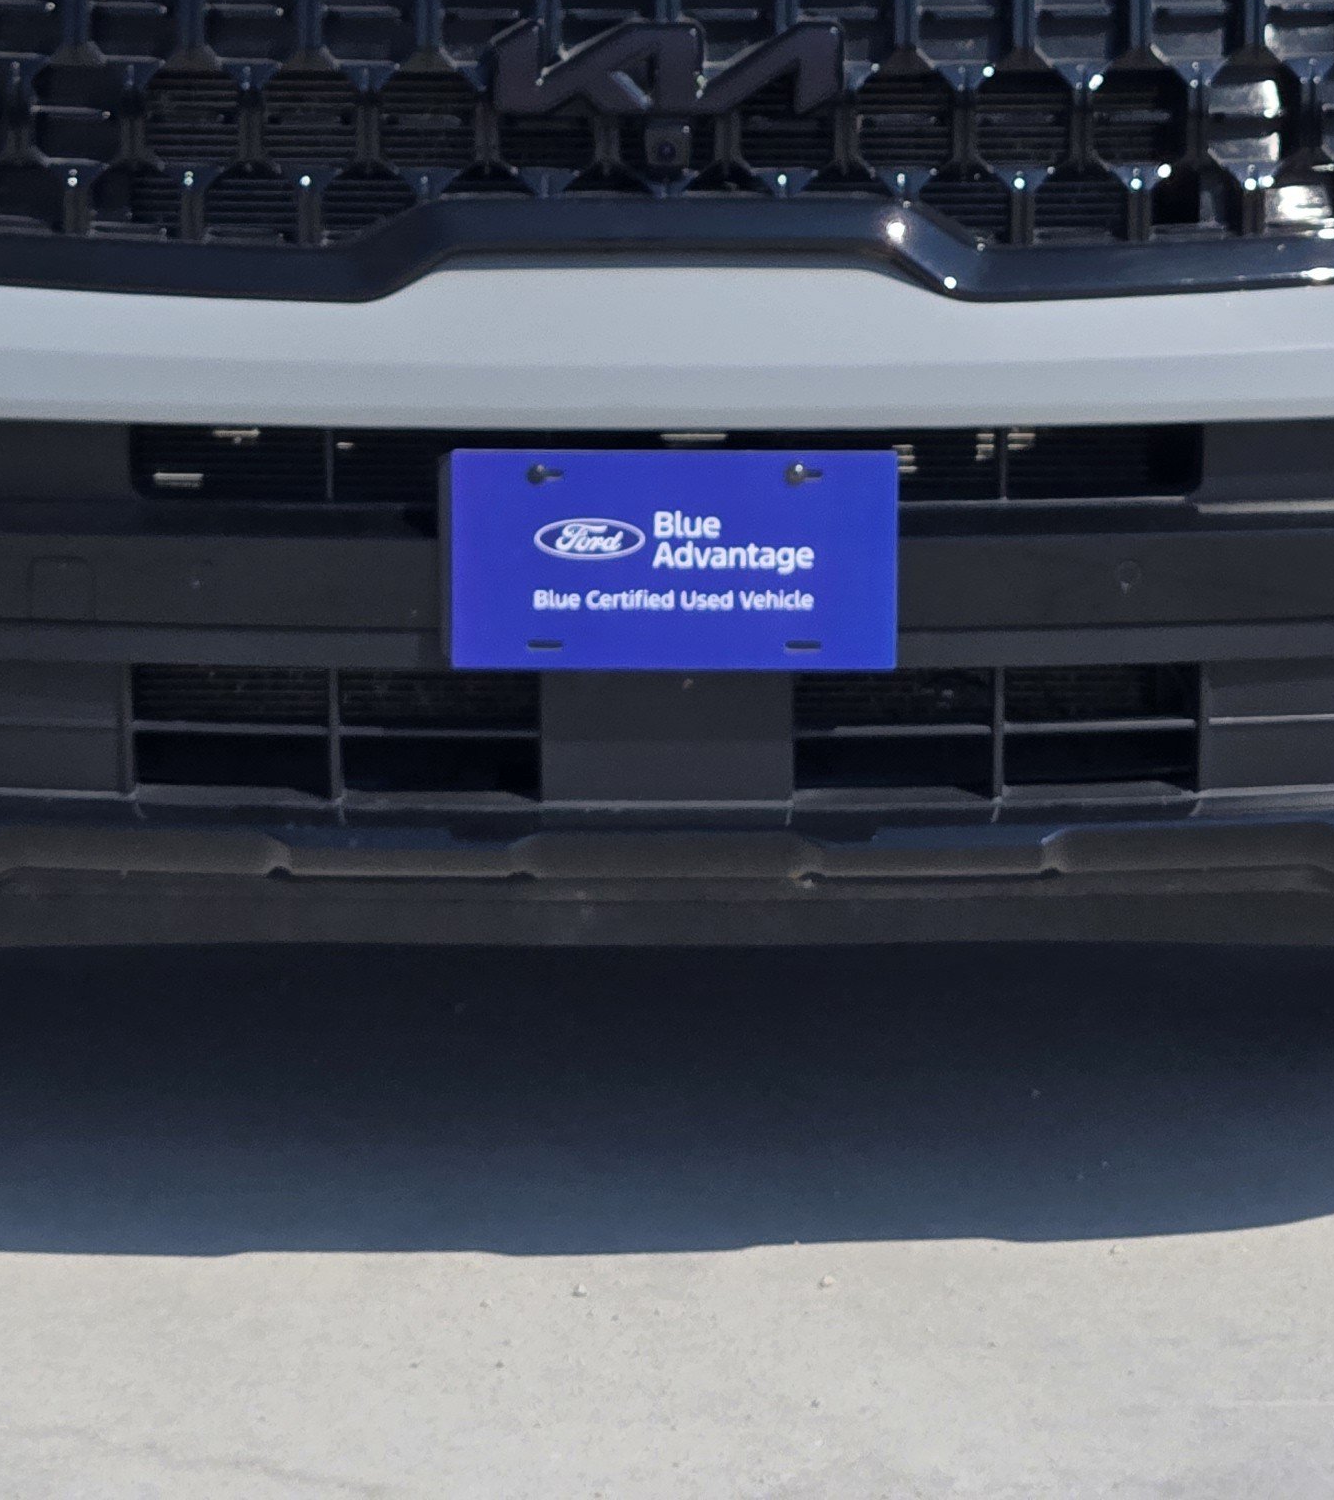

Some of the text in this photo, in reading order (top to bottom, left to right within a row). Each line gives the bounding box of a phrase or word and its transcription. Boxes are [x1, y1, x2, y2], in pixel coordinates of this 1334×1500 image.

[554, 524, 624, 553] Ford
[653, 511, 721, 539] Blue
[652, 541, 815, 575] Advantage
[533, 588, 815, 611] Blue Certified Used Vehicle
